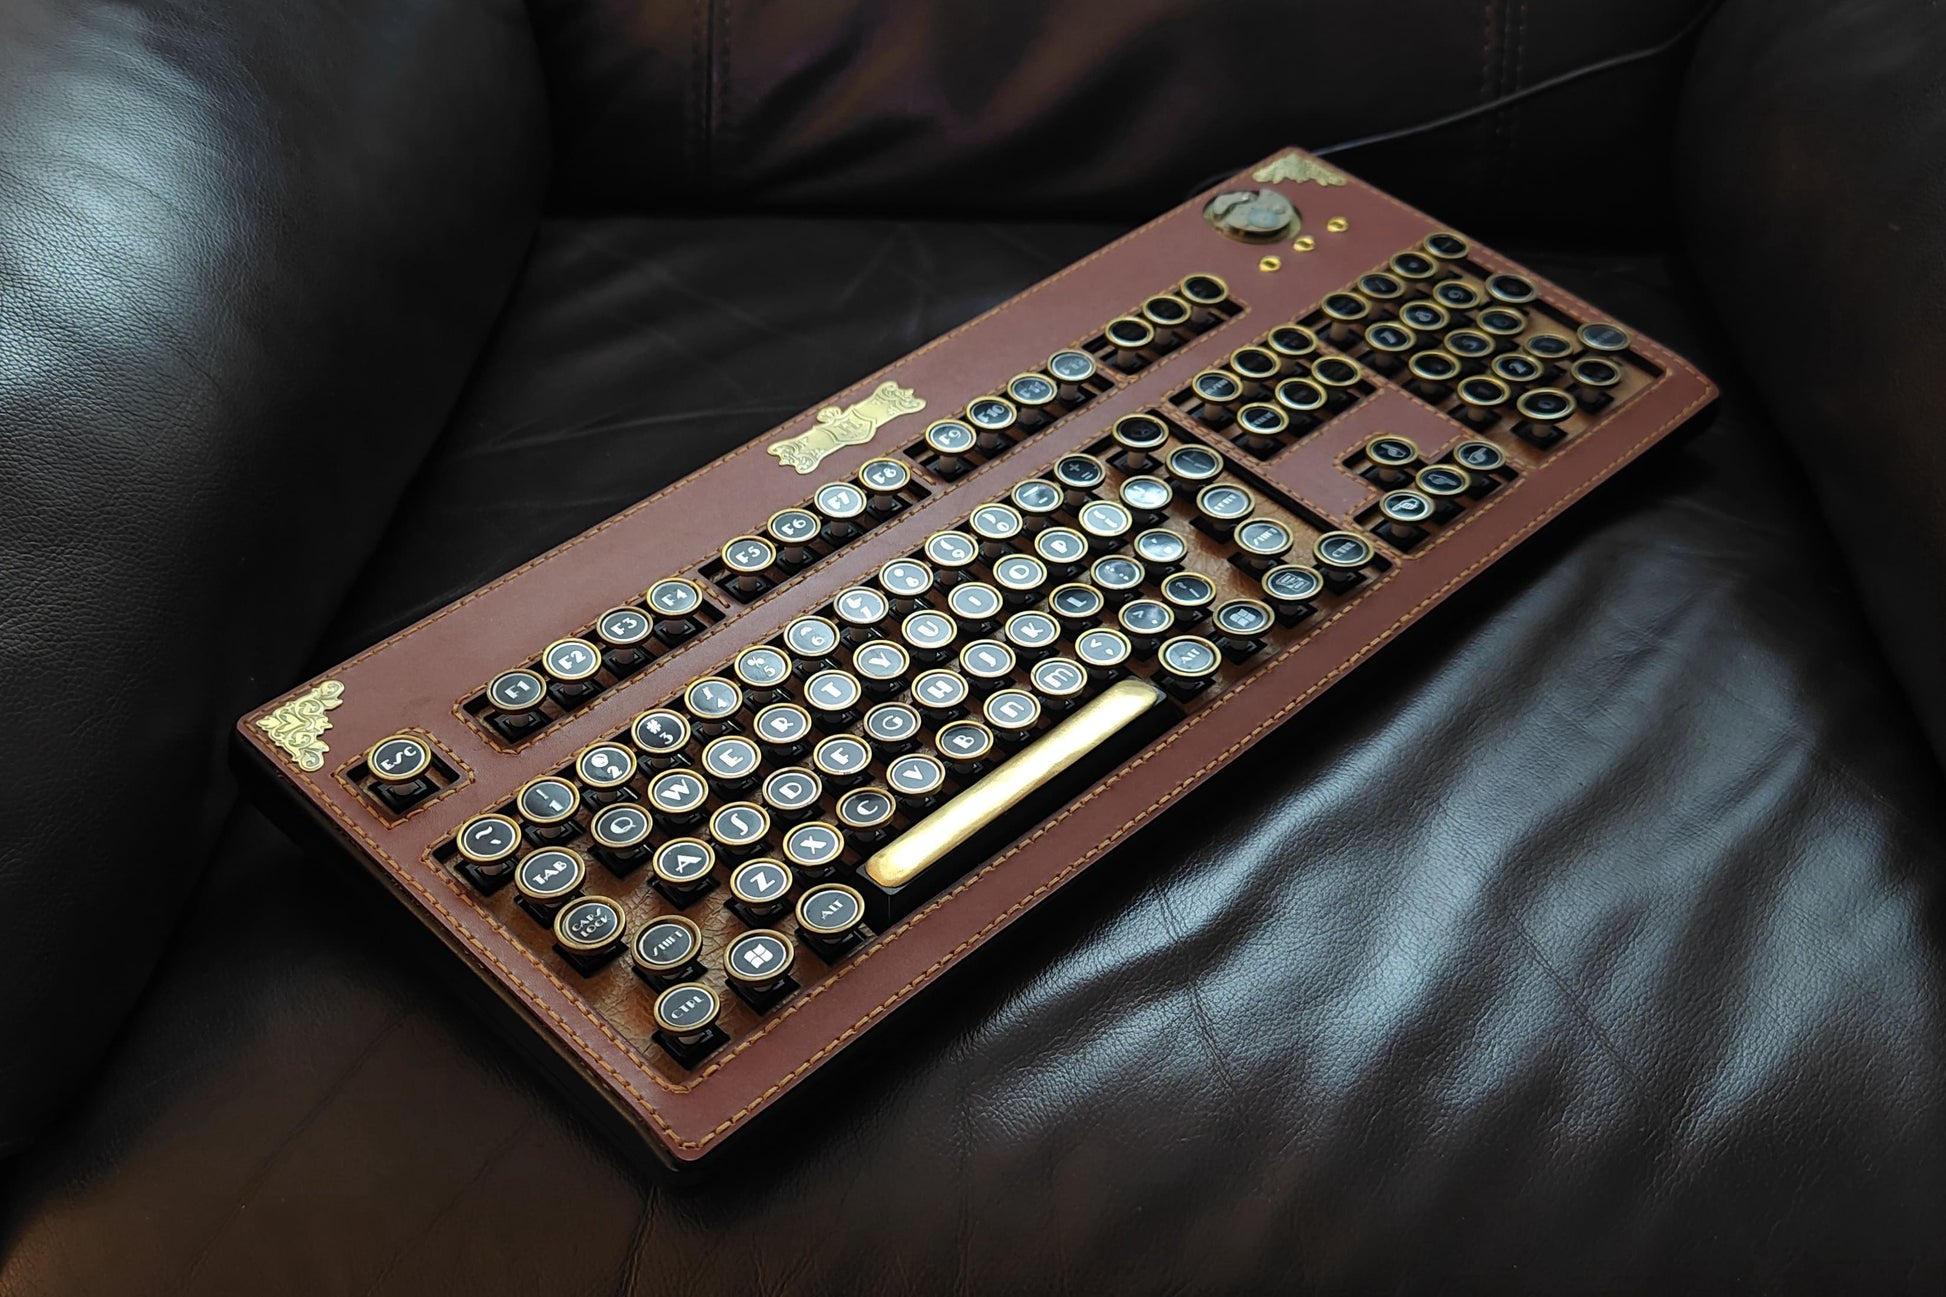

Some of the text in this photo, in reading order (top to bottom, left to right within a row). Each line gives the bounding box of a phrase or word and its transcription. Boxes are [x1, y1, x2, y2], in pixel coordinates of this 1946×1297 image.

[1415, 310, 1432, 321] 8
[1380, 330, 1397, 343] 7
[1508, 362, 1527, 374] 2
[978, 405, 1004, 423] F10
[938, 430, 962, 446] F9
[872, 468, 897, 484] F8
[827, 491, 850, 509] F7
[781, 518, 807, 535] F6
[735, 546, 761, 564] F5
[952, 548, 965, 560] 9
[1050, 540, 1068, 554] P
[1008, 564, 1030, 580] O
[905, 576, 920, 588] 8
[661, 588, 688, 607] F4
[968, 596, 982, 607] I
[1066, 596, 1087, 608] L
[860, 606, 872, 619] 7
[610, 617, 638, 636] F3
[917, 620, 939, 637] U
[1020, 622, 1044, 638] K
[812, 636, 824, 646] 6
[558, 650, 587, 670] F2
[868, 652, 892, 668] Y
[978, 651, 997, 668] J
[764, 665, 776, 677] 5
[504, 680, 531, 700] F1
[820, 682, 842, 698] T
[927, 680, 954, 700] H
[718, 697, 728, 708] 4
[770, 717, 794, 733] R
[882, 715, 904, 730] G
[659, 732, 674, 745] 3
[952, 734, 976, 750] B
[381, 746, 418, 771] ESC
[719, 748, 744, 768] E
[830, 747, 850, 766] F
[606, 765, 623, 780] 2
[902, 764, 924, 780] V
[660, 778, 690, 801] W
[778, 782, 803, 800] D
[549, 799, 564, 812] 1
[856, 800, 878, 816] C
[610, 816, 636, 834] Q
[730, 812, 749, 836] S
[800, 835, 827, 854] X
[676, 854, 702, 874] A
[532, 860, 568, 886] TAB
[750, 871, 776, 892] Z
[572, 908, 602, 932] CAPS
[580, 916, 610, 938] LOCK
[670, 995, 704, 1020] CTRL
